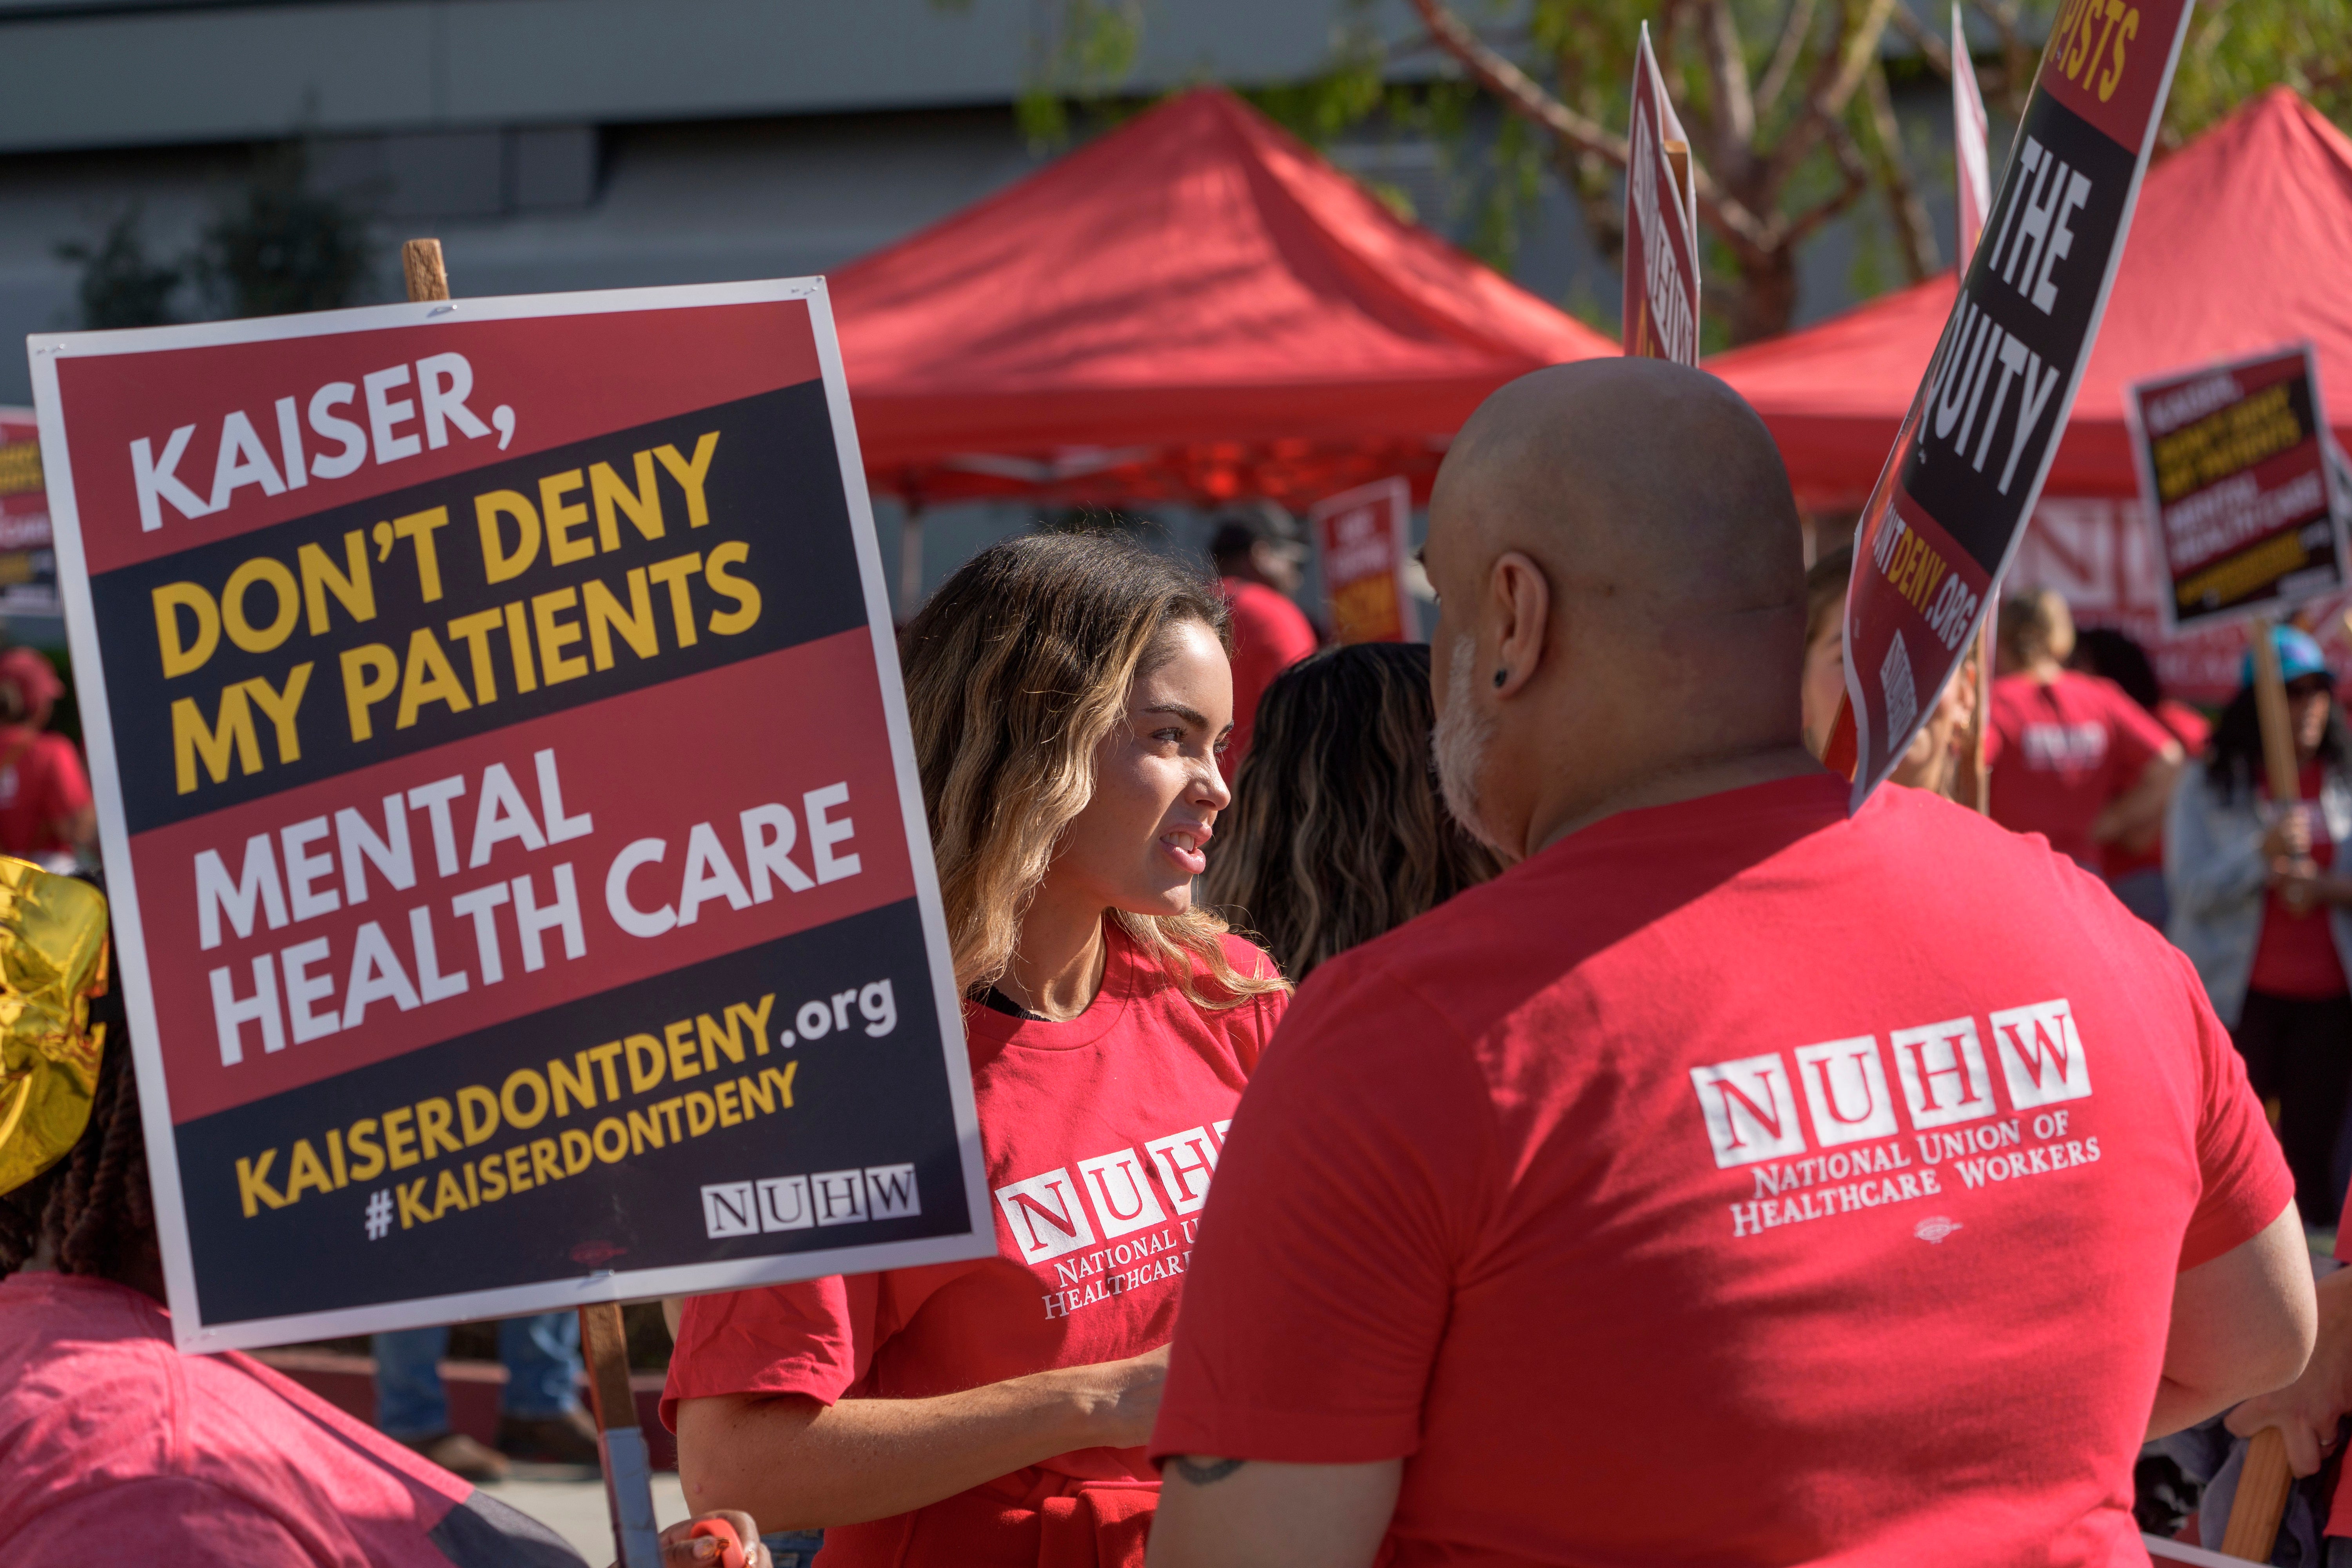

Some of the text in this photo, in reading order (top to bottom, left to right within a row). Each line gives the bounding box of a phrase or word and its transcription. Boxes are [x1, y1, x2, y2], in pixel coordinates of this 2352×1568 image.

[1989, 135, 2092, 315] THE
[130, 351, 516, 533] KAISER,
[152, 431, 720, 679] DON'T DENY
[171, 541, 762, 795] MY PATIENTS
[194, 748, 593, 950] MENTAL
[209, 781, 862, 1067] HEALTH CARE
[235, 978, 897, 1217] KAISERDONTDENY.org
[365, 1061, 799, 1241] #KAISERDONTDENY
[1690, 998, 2092, 1169] NUHW
[1752, 1111, 2069, 1200] NATIONAL UNION OF
[701, 1163, 921, 1238] NUHW
[994, 1119, 1234, 1265] NUH
[1054, 1230, 1176, 1288] NATIONAL
[1730, 1169, 1941, 1237] HEALTHCARE
[1955, 1137, 2102, 1190] WORKERS
